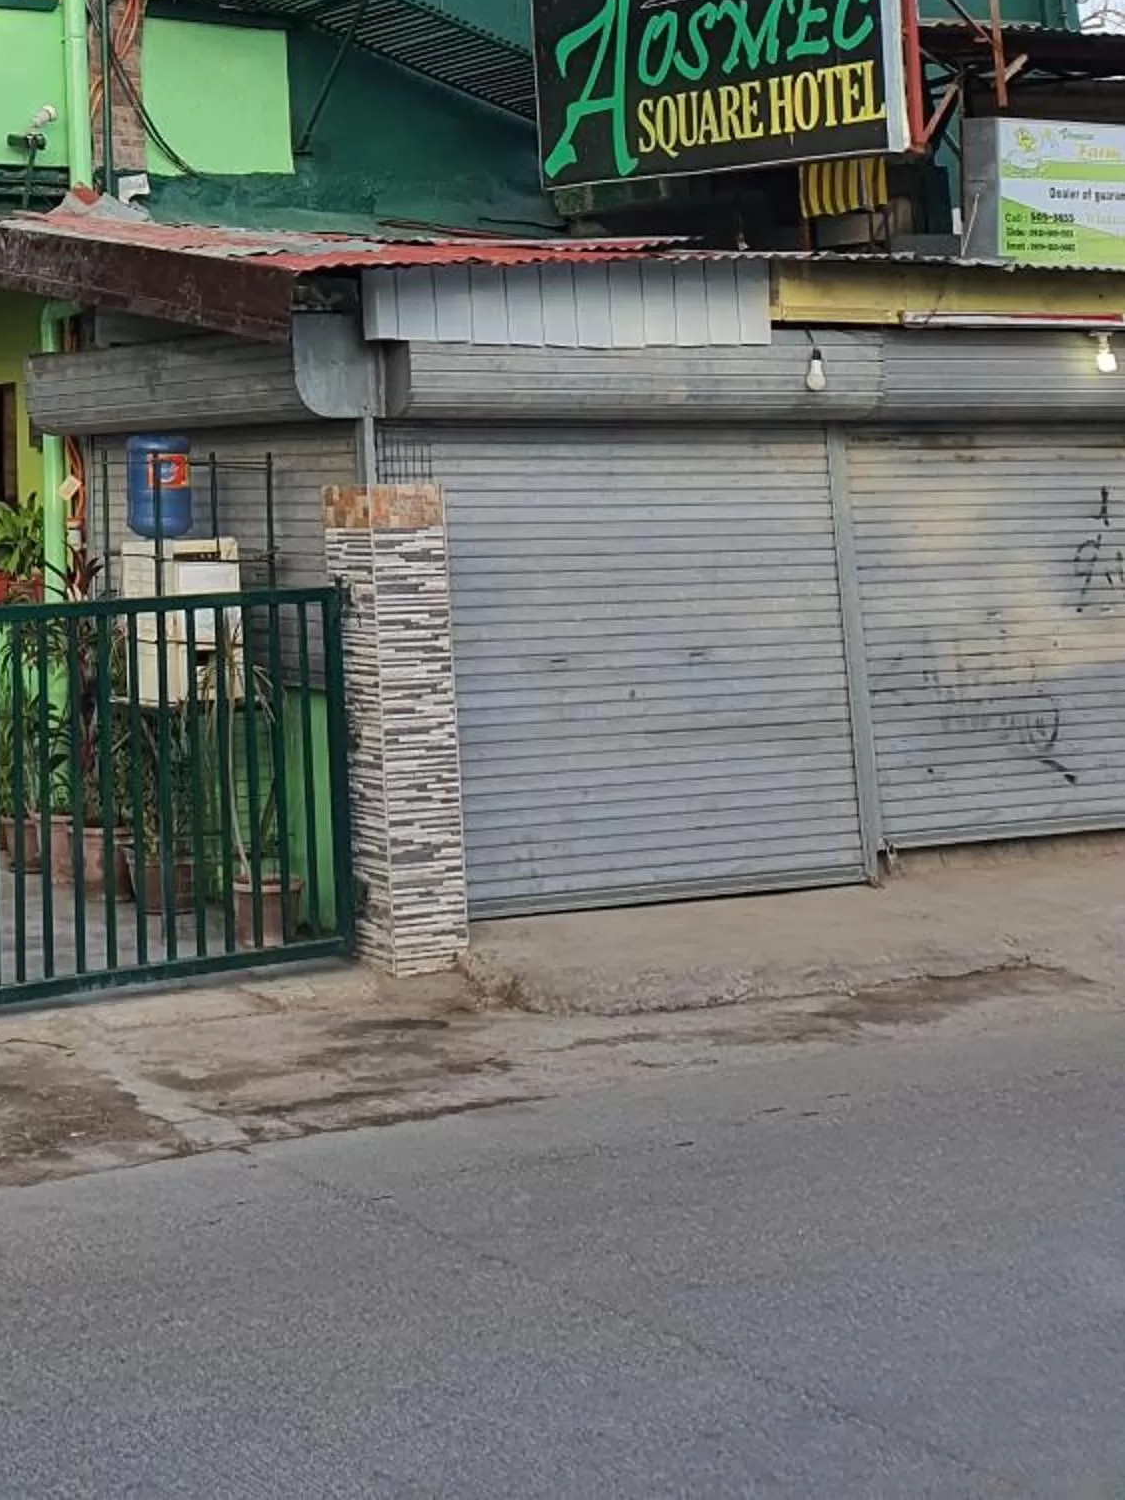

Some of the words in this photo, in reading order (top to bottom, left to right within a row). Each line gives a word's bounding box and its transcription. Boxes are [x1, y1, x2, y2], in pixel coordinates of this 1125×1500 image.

[638, 81, 764, 156] SQUARE
[770, 60, 886, 134] HOTEL
[1082, 187, 1092, 200] of
